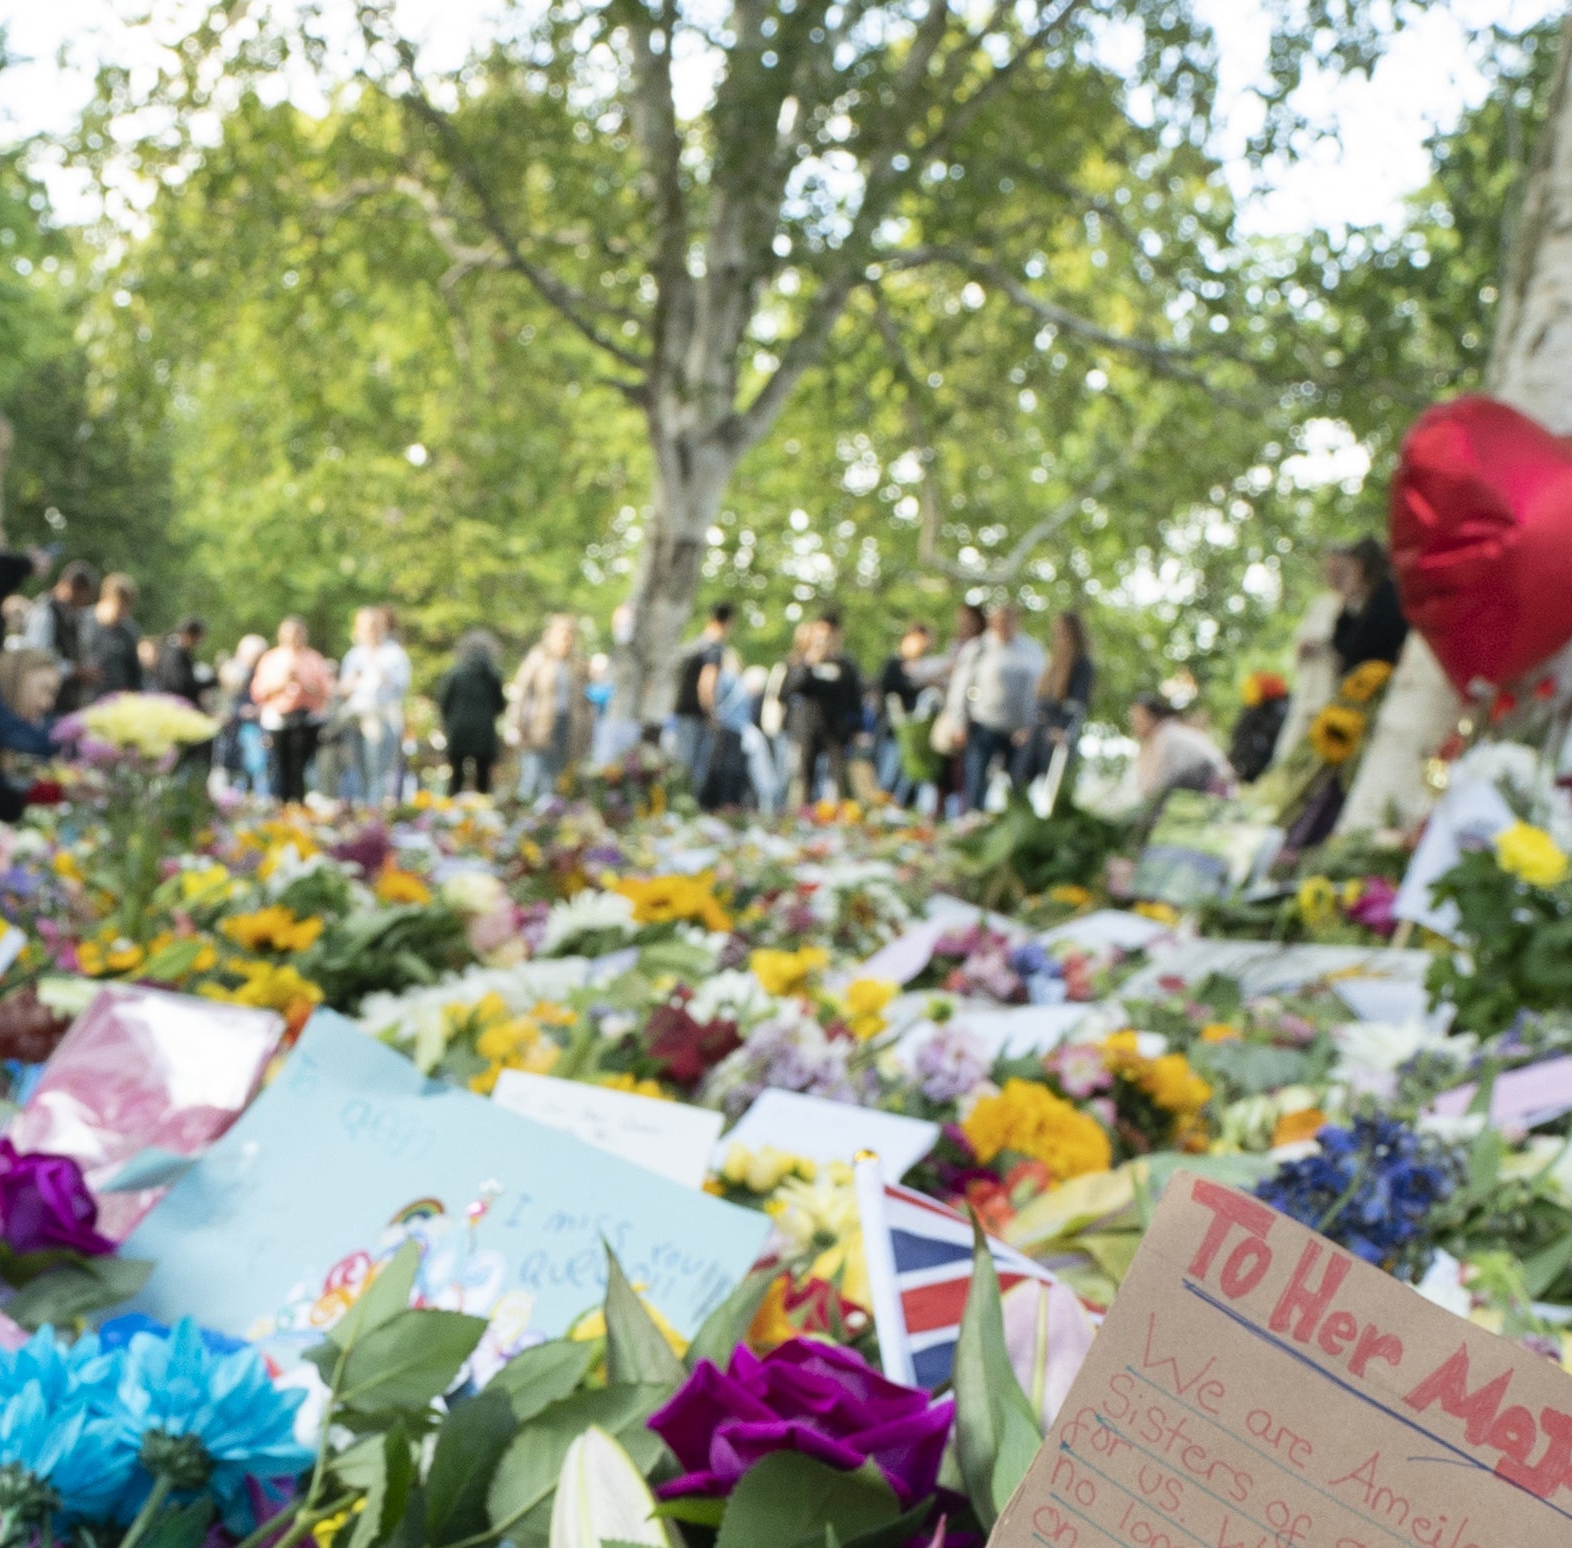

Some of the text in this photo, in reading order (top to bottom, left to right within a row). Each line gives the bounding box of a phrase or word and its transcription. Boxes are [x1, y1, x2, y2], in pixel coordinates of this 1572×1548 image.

[1188, 1178, 1277, 1299] To
[1268, 1238, 1404, 1379] Her
[1143, 1311, 1225, 1416] We
[1246, 1409, 1313, 1469] are
[1050, 1455, 1096, 1507] no
[1059, 1406, 1133, 1457] for
[1137, 1463, 1186, 1524] us.
